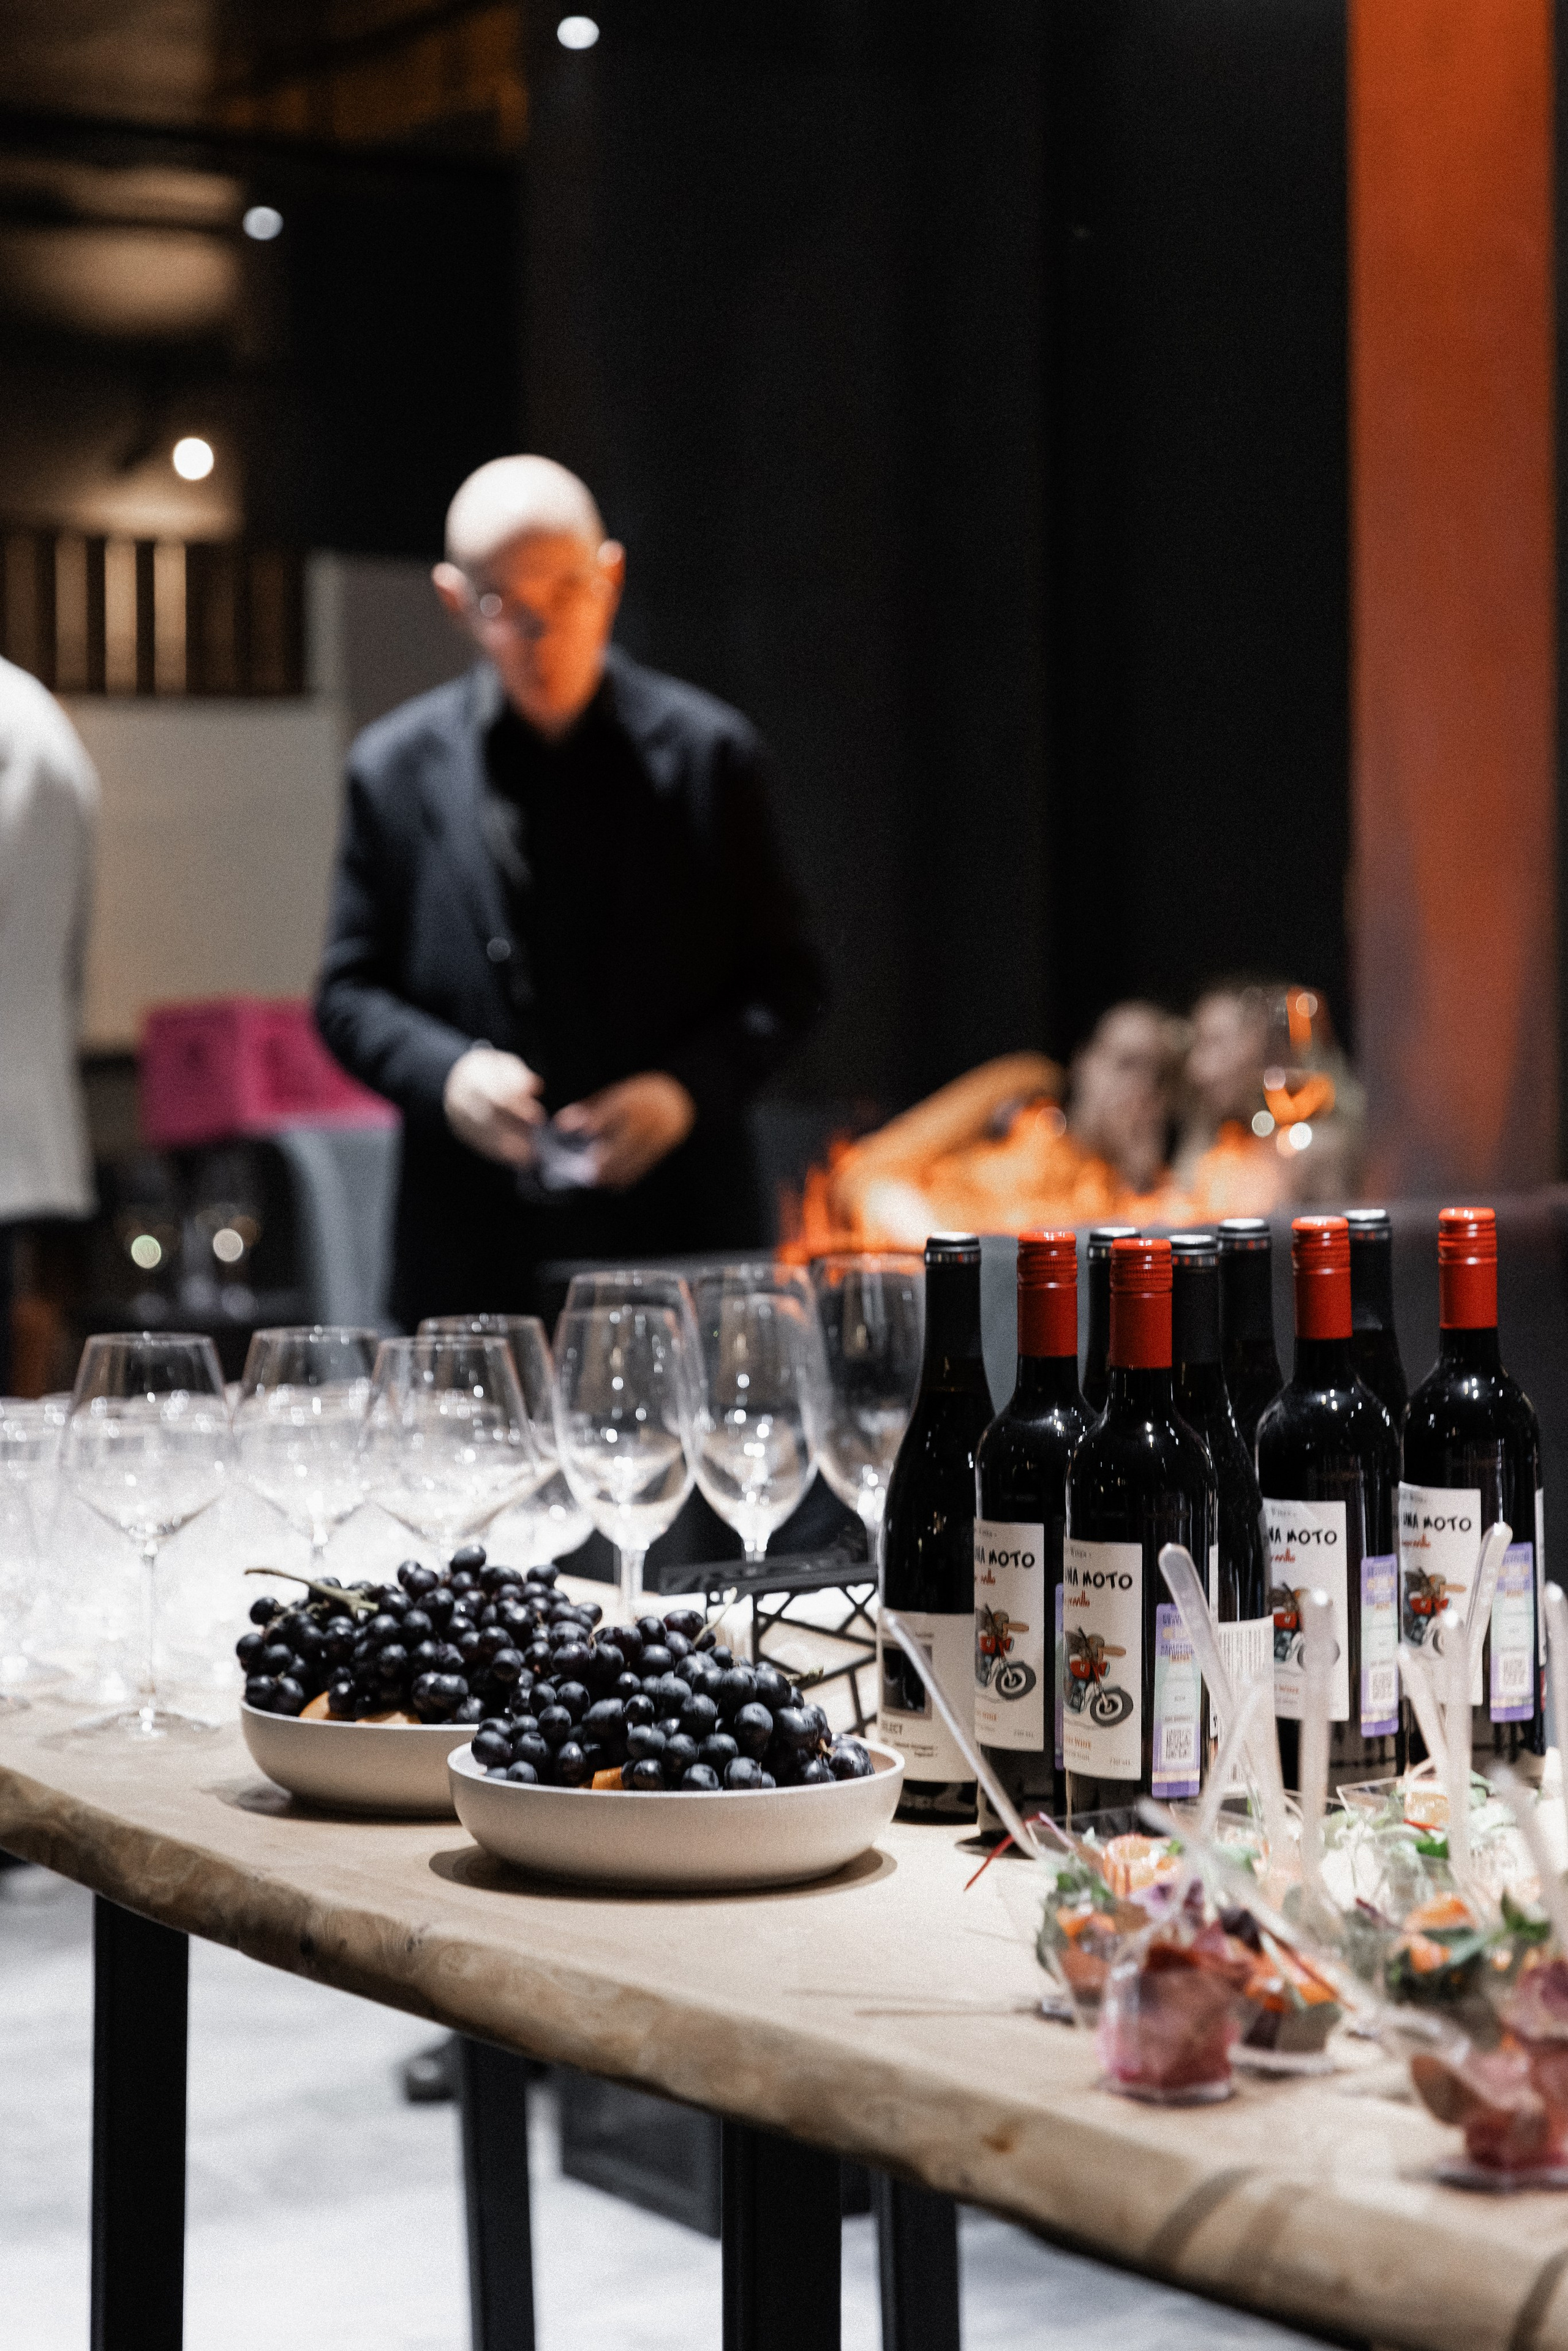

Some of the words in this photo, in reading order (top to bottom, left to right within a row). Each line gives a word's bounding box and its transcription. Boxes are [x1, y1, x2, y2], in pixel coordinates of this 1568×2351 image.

[1423, 1515, 1471, 1532] MOTO
[1287, 1528, 1337, 1544] MOTO
[989, 1549, 1035, 1568] MOTO
[1082, 1569, 1133, 1590] MOTO
